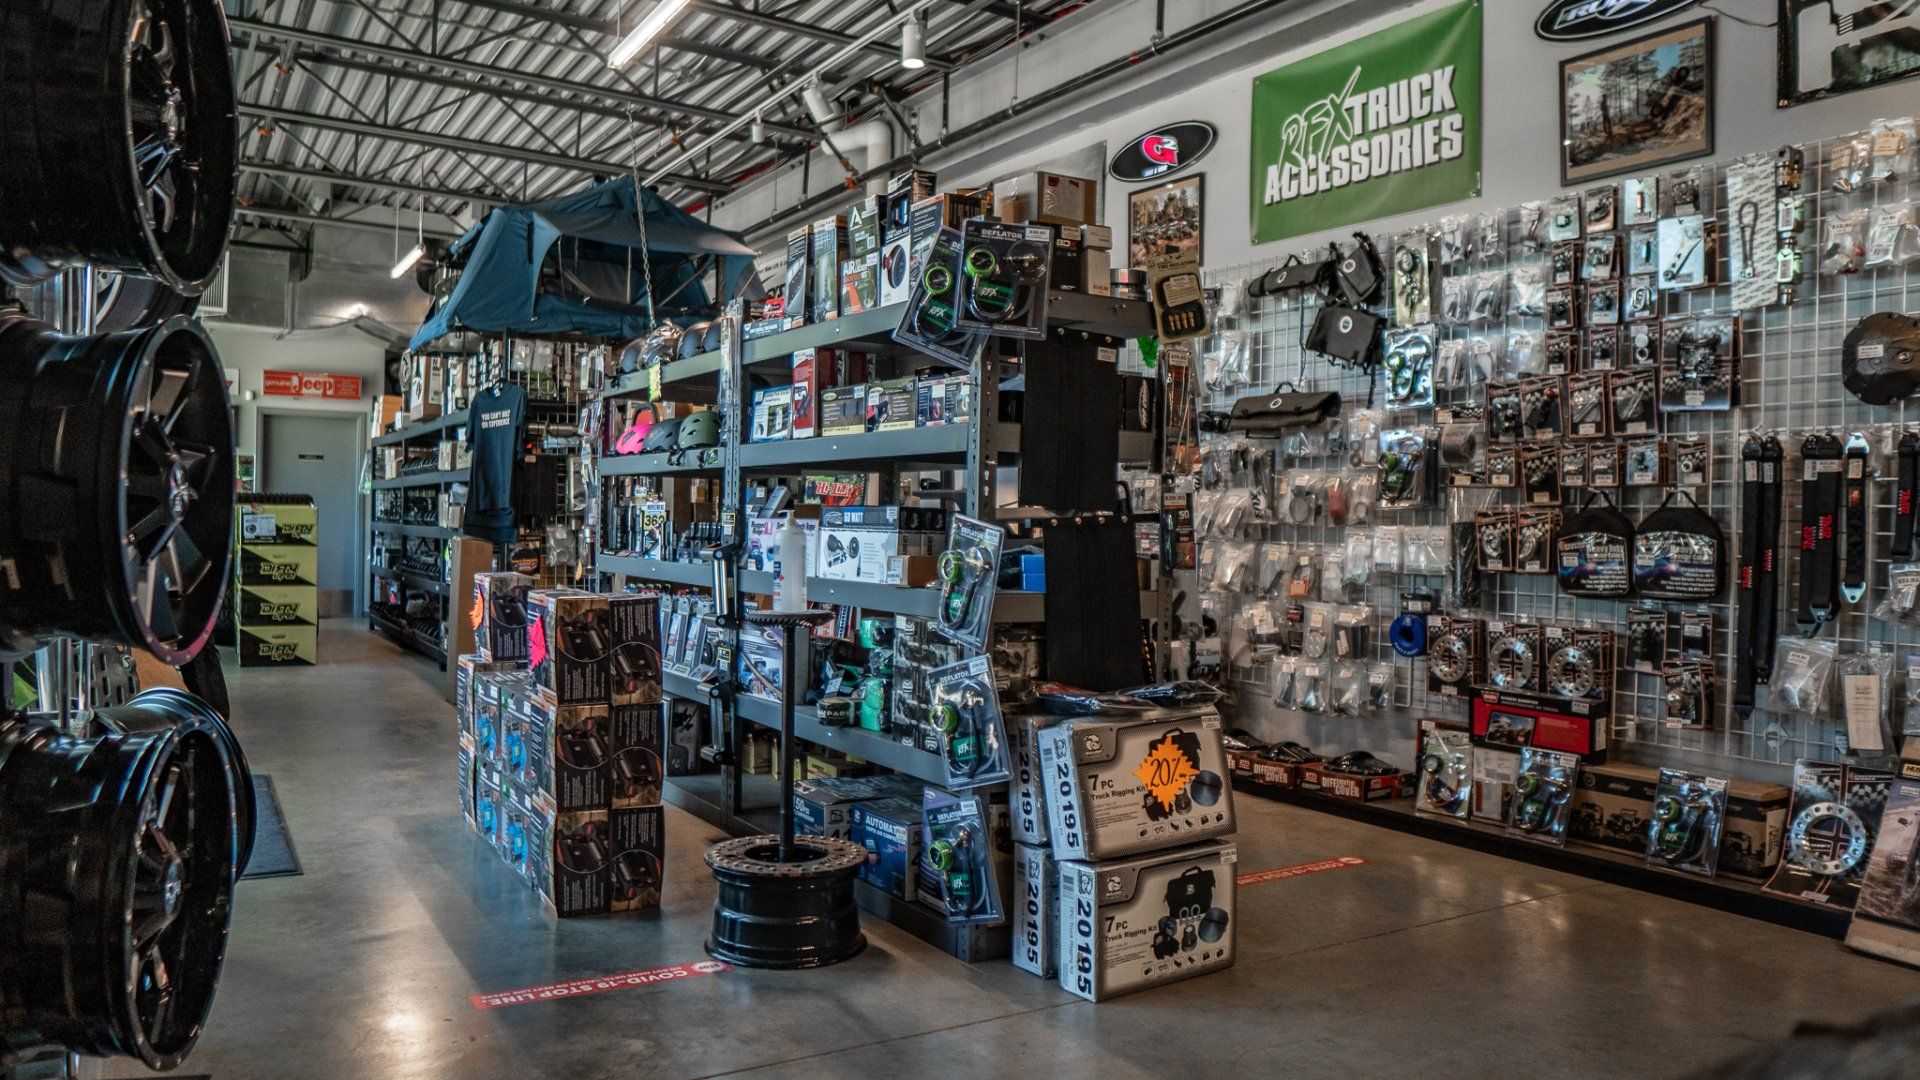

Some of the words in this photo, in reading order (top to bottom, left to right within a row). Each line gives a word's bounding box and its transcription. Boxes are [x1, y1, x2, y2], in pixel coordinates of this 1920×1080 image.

[1345, 65, 1456, 136] TRUCK
[1264, 113, 1464, 205] ACCESSORIES
[981, 229, 1023, 239] DEFLATOR
[980, 287, 998, 297] RFX
[292, 374, 333, 399] Jeep
[488, 418, 511, 428] EXPERIENCE
[940, 671, 969, 683] DEFLATOR
[1088, 774, 1100, 791] 7
[1101, 779, 1114, 790] PC
[1019, 751, 1034, 834] 20195
[1091, 792, 1110, 801] Truck
[1111, 788, 1135, 798] Rigging
[1335, 785, 1360, 798] COVER
[1057, 763, 1080, 848] 20195
[1026, 881, 1039, 966] 20195
[1105, 916, 1116, 933] 7
[1116, 921, 1128, 931] PC
[1105, 933, 1122, 943] Truck
[1124, 928, 1147, 938] Rigging
[1077, 897, 1092, 996] 20195
[598, 969, 688, 990] COVID-19
[540, 984, 593, 1000] STOP
